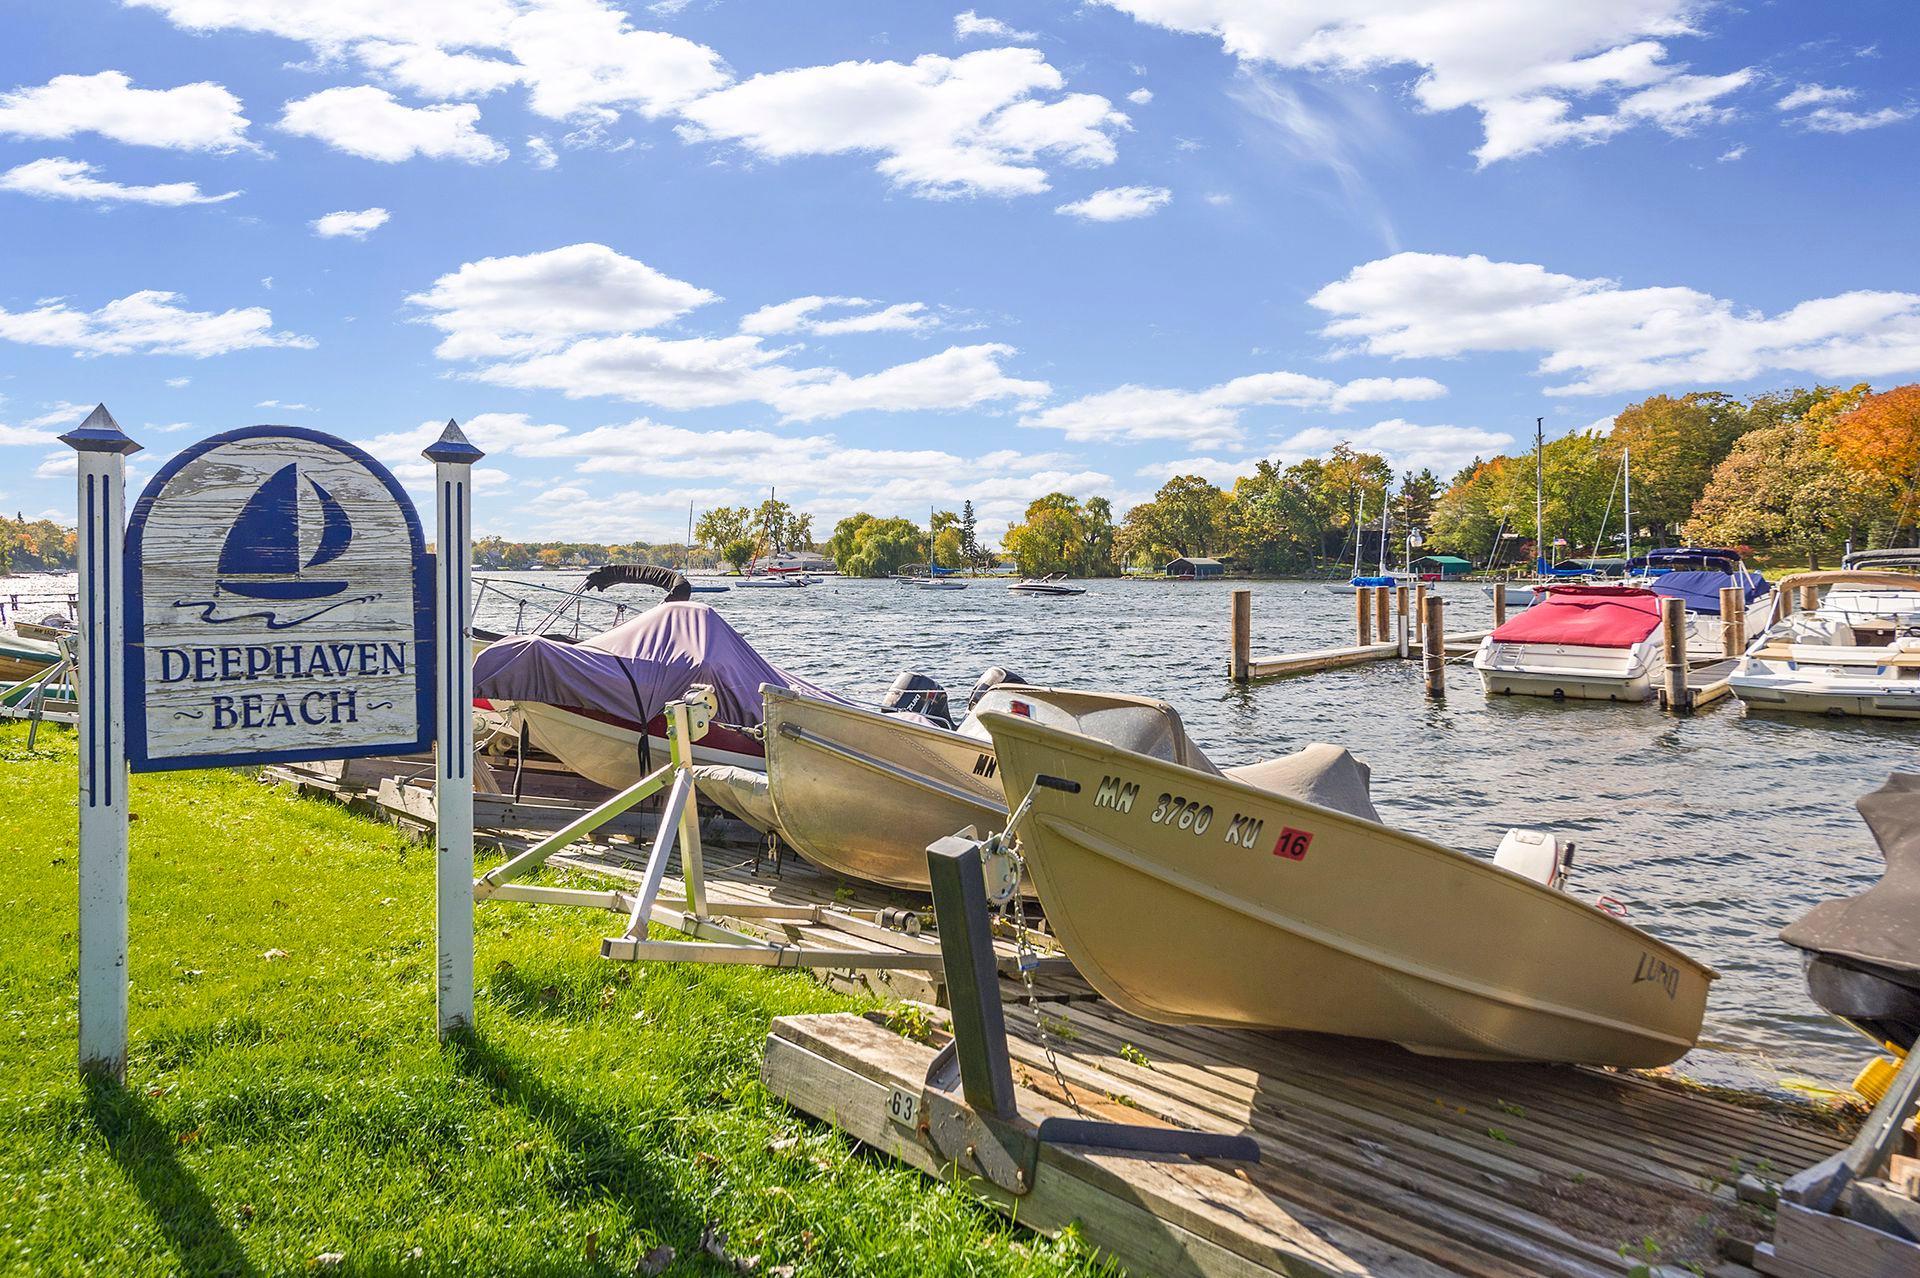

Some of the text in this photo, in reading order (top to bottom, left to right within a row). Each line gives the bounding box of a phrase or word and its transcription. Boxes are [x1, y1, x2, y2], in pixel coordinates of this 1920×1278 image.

[160, 642, 406, 683] DEEPHAVEN
[212, 690, 358, 730] BEACH
[972, 753, 997, 779] MN
[1094, 775, 1264, 849] MN 3760 KU
[1280, 832, 1307, 857] 16
[1632, 951, 1680, 1001] LUND
[892, 1091, 913, 1121] 63
